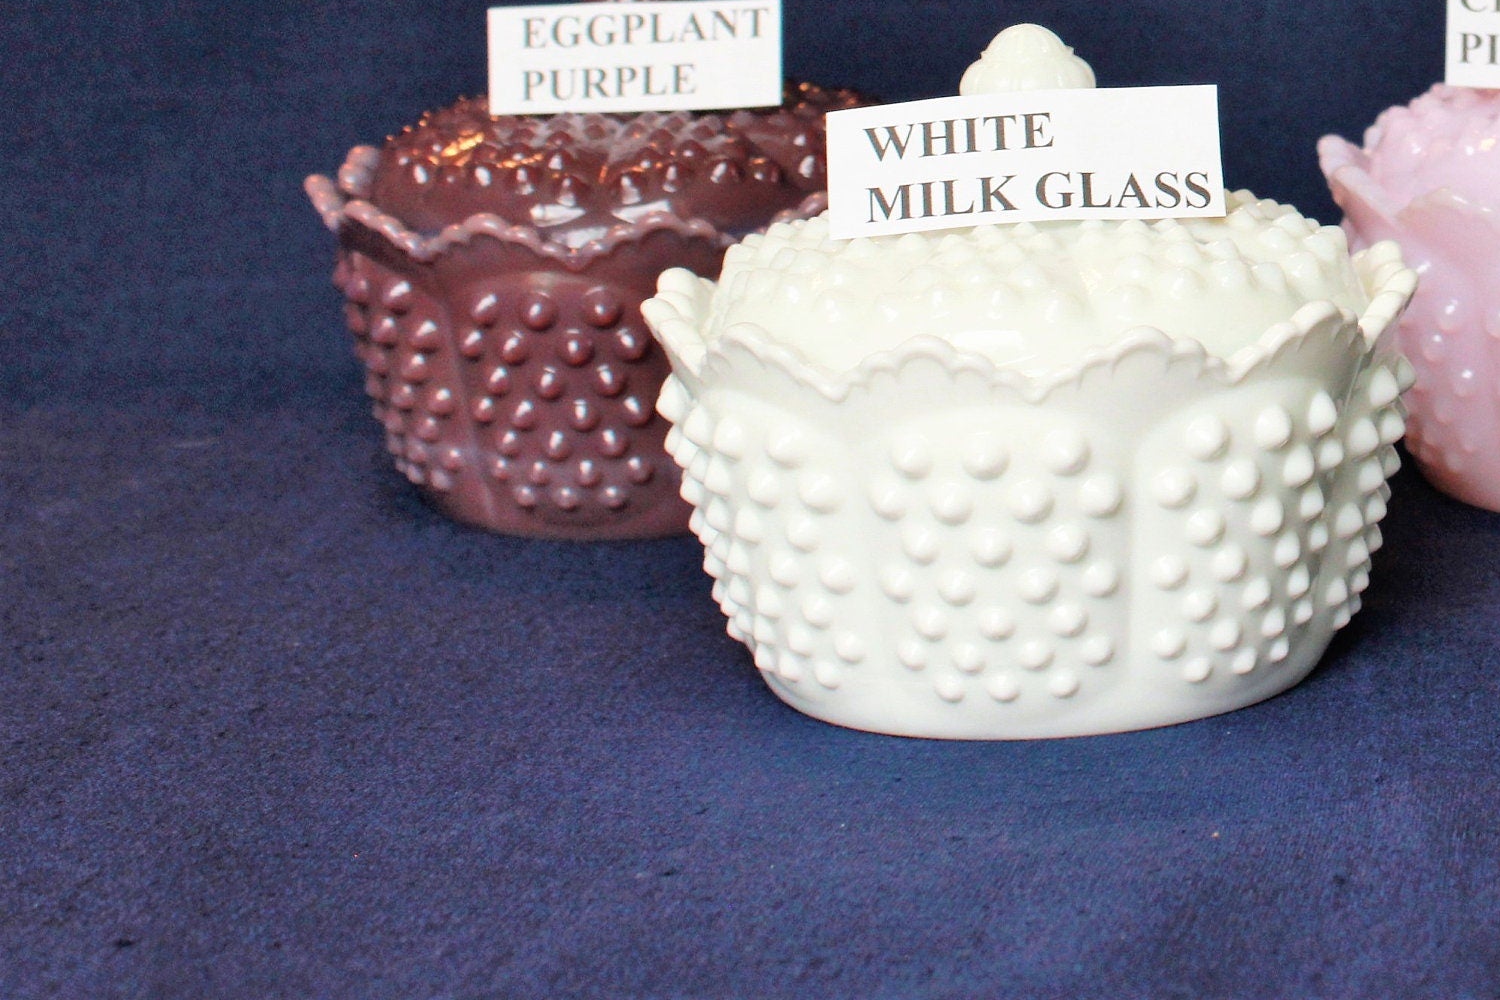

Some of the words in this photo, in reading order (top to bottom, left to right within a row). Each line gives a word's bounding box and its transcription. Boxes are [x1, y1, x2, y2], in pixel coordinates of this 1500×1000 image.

[522, 8, 769, 49] EGGPLANT
[522, 63, 696, 101] PURPLE
[863, 112, 1055, 162] WHITE
[867, 174, 1020, 223] MILK
[1035, 171, 1211, 209] GLASS
